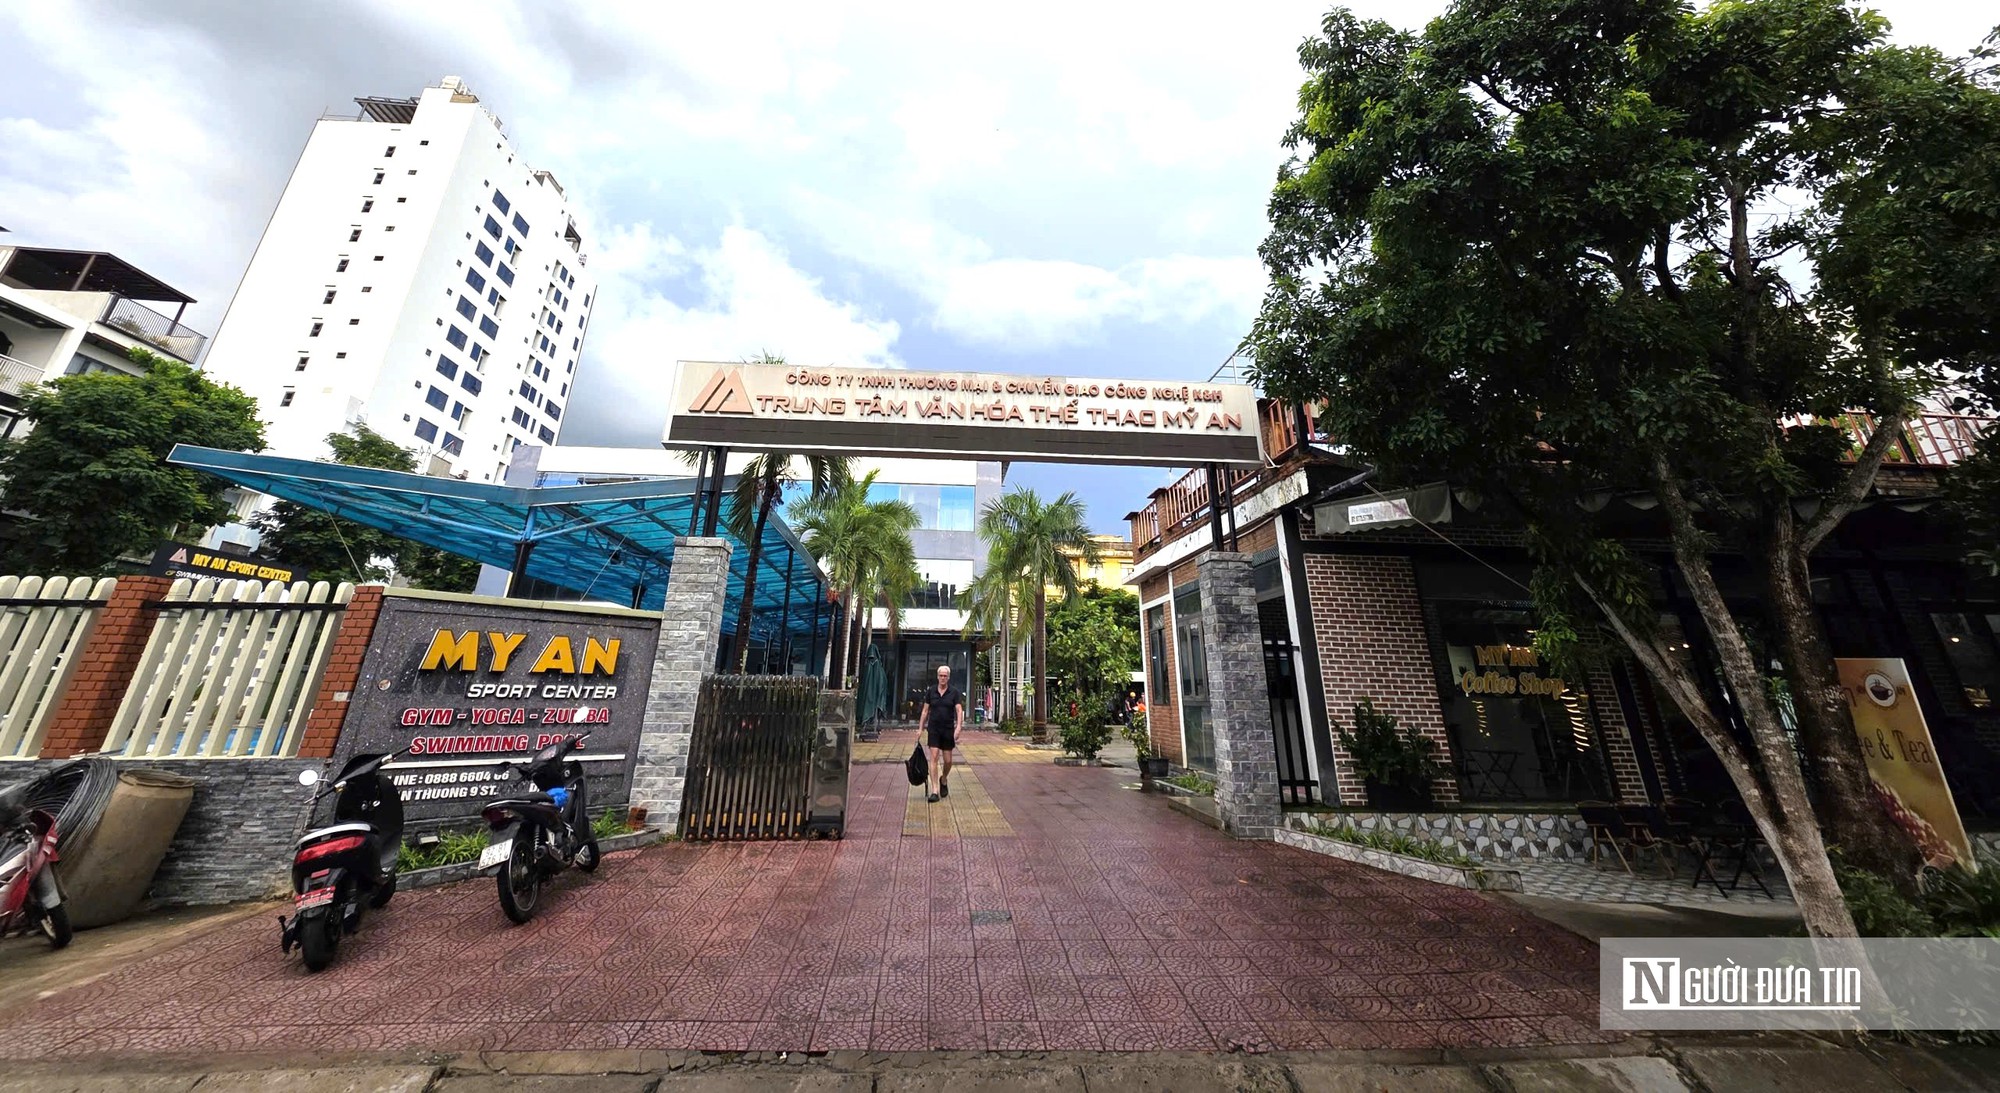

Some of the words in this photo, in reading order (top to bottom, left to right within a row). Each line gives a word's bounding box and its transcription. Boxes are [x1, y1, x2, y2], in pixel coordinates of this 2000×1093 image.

[786, 371, 831, 386] CÔNG
[836, 375, 853, 387] TY
[858, 376, 896, 390] TNHH
[961, 378, 988, 395] MẠI
[992, 380, 1001, 392] &
[1064, 384, 1100, 397] GIAO
[1104, 383, 1147, 399] CÔNG
[1152, 386, 1189, 404] NGHỆ
[757, 394, 846, 416] TRUNG
[855, 394, 908, 417] TÂM
[915, 394, 965, 419] VĂN
[971, 399, 1024, 423] HÓA
[1030, 399, 1079, 425] THỂ
[1086, 408, 1157, 427] THAO
[1162, 407, 1199, 429] MỸ
[1206, 412, 1242, 430] AN
[191, 553, 211, 567] MY
[210, 559, 225, 571] AN
[227, 562, 256, 577] SPORT
[258, 566, 292, 582] CENTER
[418, 628, 527, 673] MY
[528, 634, 622, 676] AN
[1475, 645, 1504, 666] MY
[1510, 647, 1538, 666] AN
[467, 682, 535, 699] SPORT
[541, 684, 618, 700] CENTER
[1462, 671, 1516, 694] Coffee
[1519, 671, 1566, 700] Shop
[401, 706, 454, 726] GYM
[471, 707, 525, 724] YOGA
[408, 734, 528, 755] SWIMMING
[1892, 730, 1933, 765] Tea
[424, 772, 457, 786] 0888
[459, 770, 491, 785] 6604
[413, 786, 469, 800] THUONG
[469, 785, 478, 797] 9
[479, 784, 498, 797] ST.
